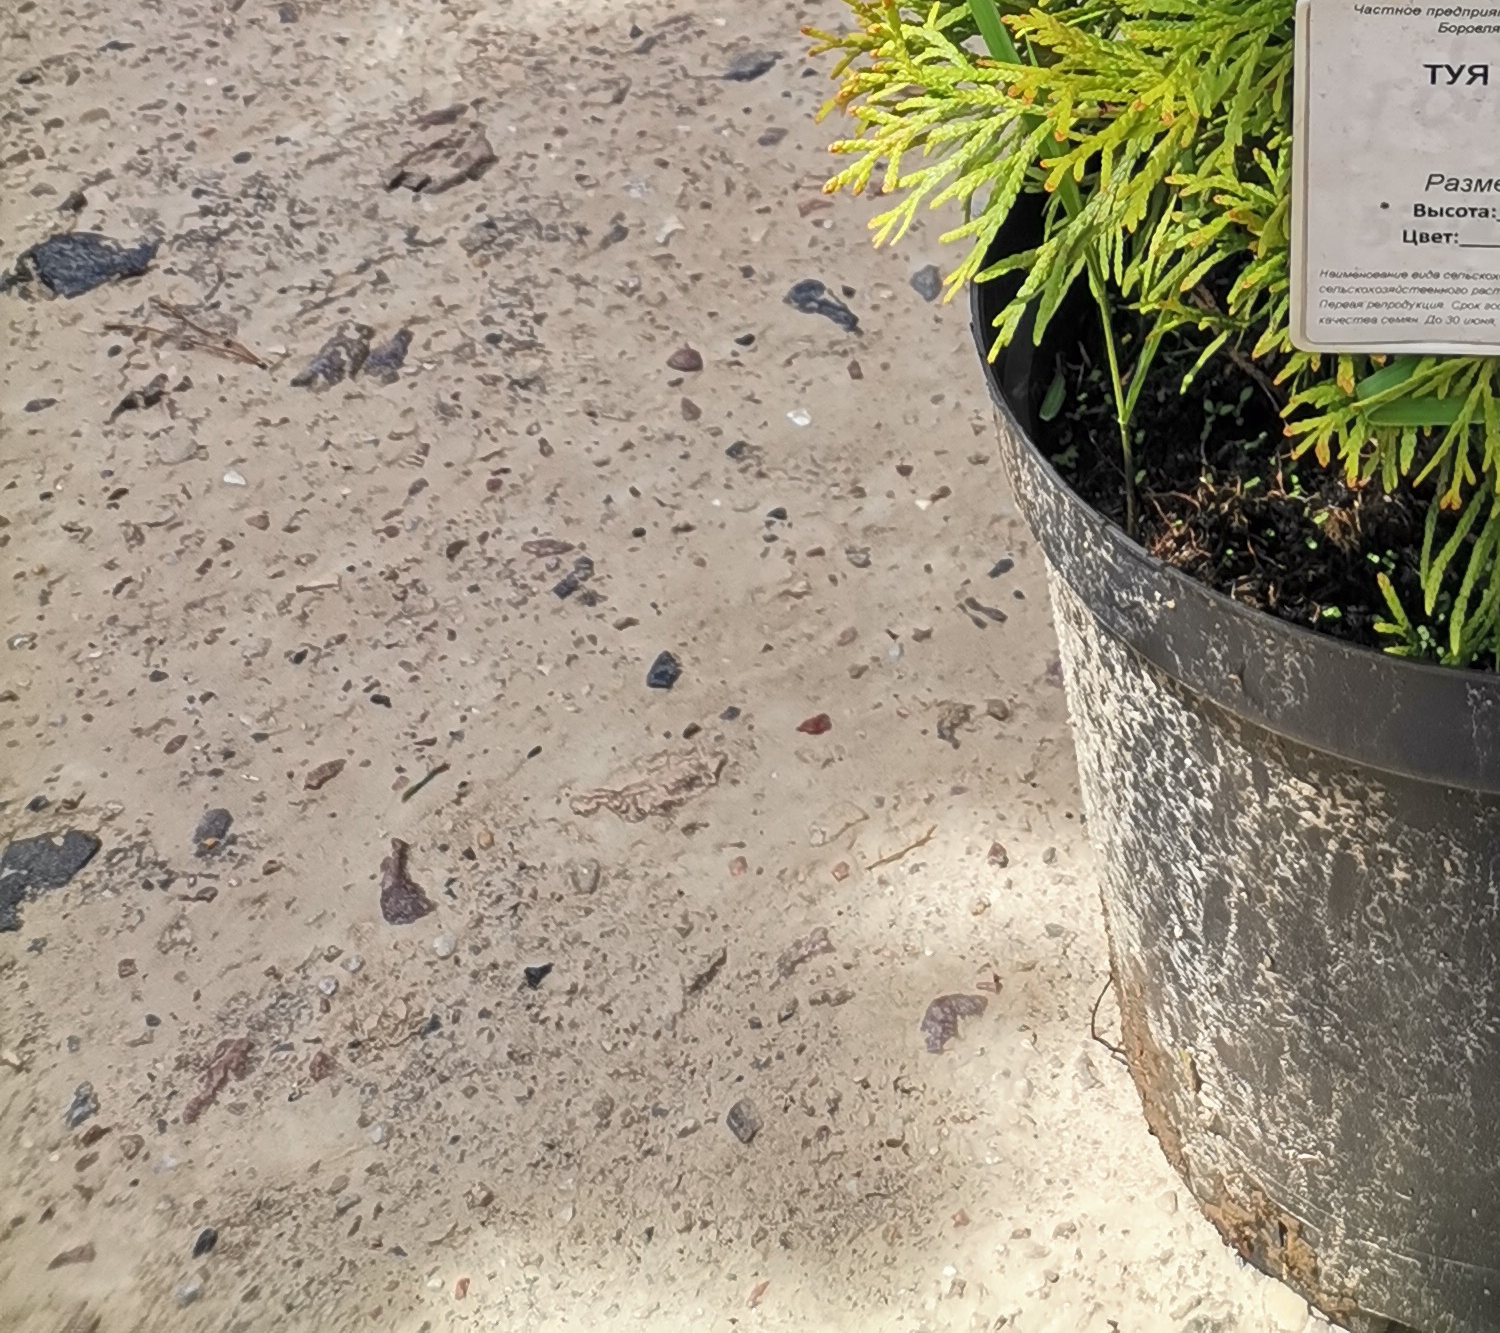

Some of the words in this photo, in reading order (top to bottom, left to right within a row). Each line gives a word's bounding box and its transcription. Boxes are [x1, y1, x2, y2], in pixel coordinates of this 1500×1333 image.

[1353, 3, 1422, 17] Частное
[1422, 63, 1490, 87] ТУЯ
[1412, 202, 1498, 220] Высота:
[1401, 229, 1460, 246] Цвет:
[1318, 268, 1409, 280] Наименование
[1318, 298, 1364, 310] Первая
[1450, 299, 1481, 311] Срок
[1318, 315, 1378, 326] качества
[1423, 314, 1443, 326] До
[1445, 314, 1461, 325] 30
